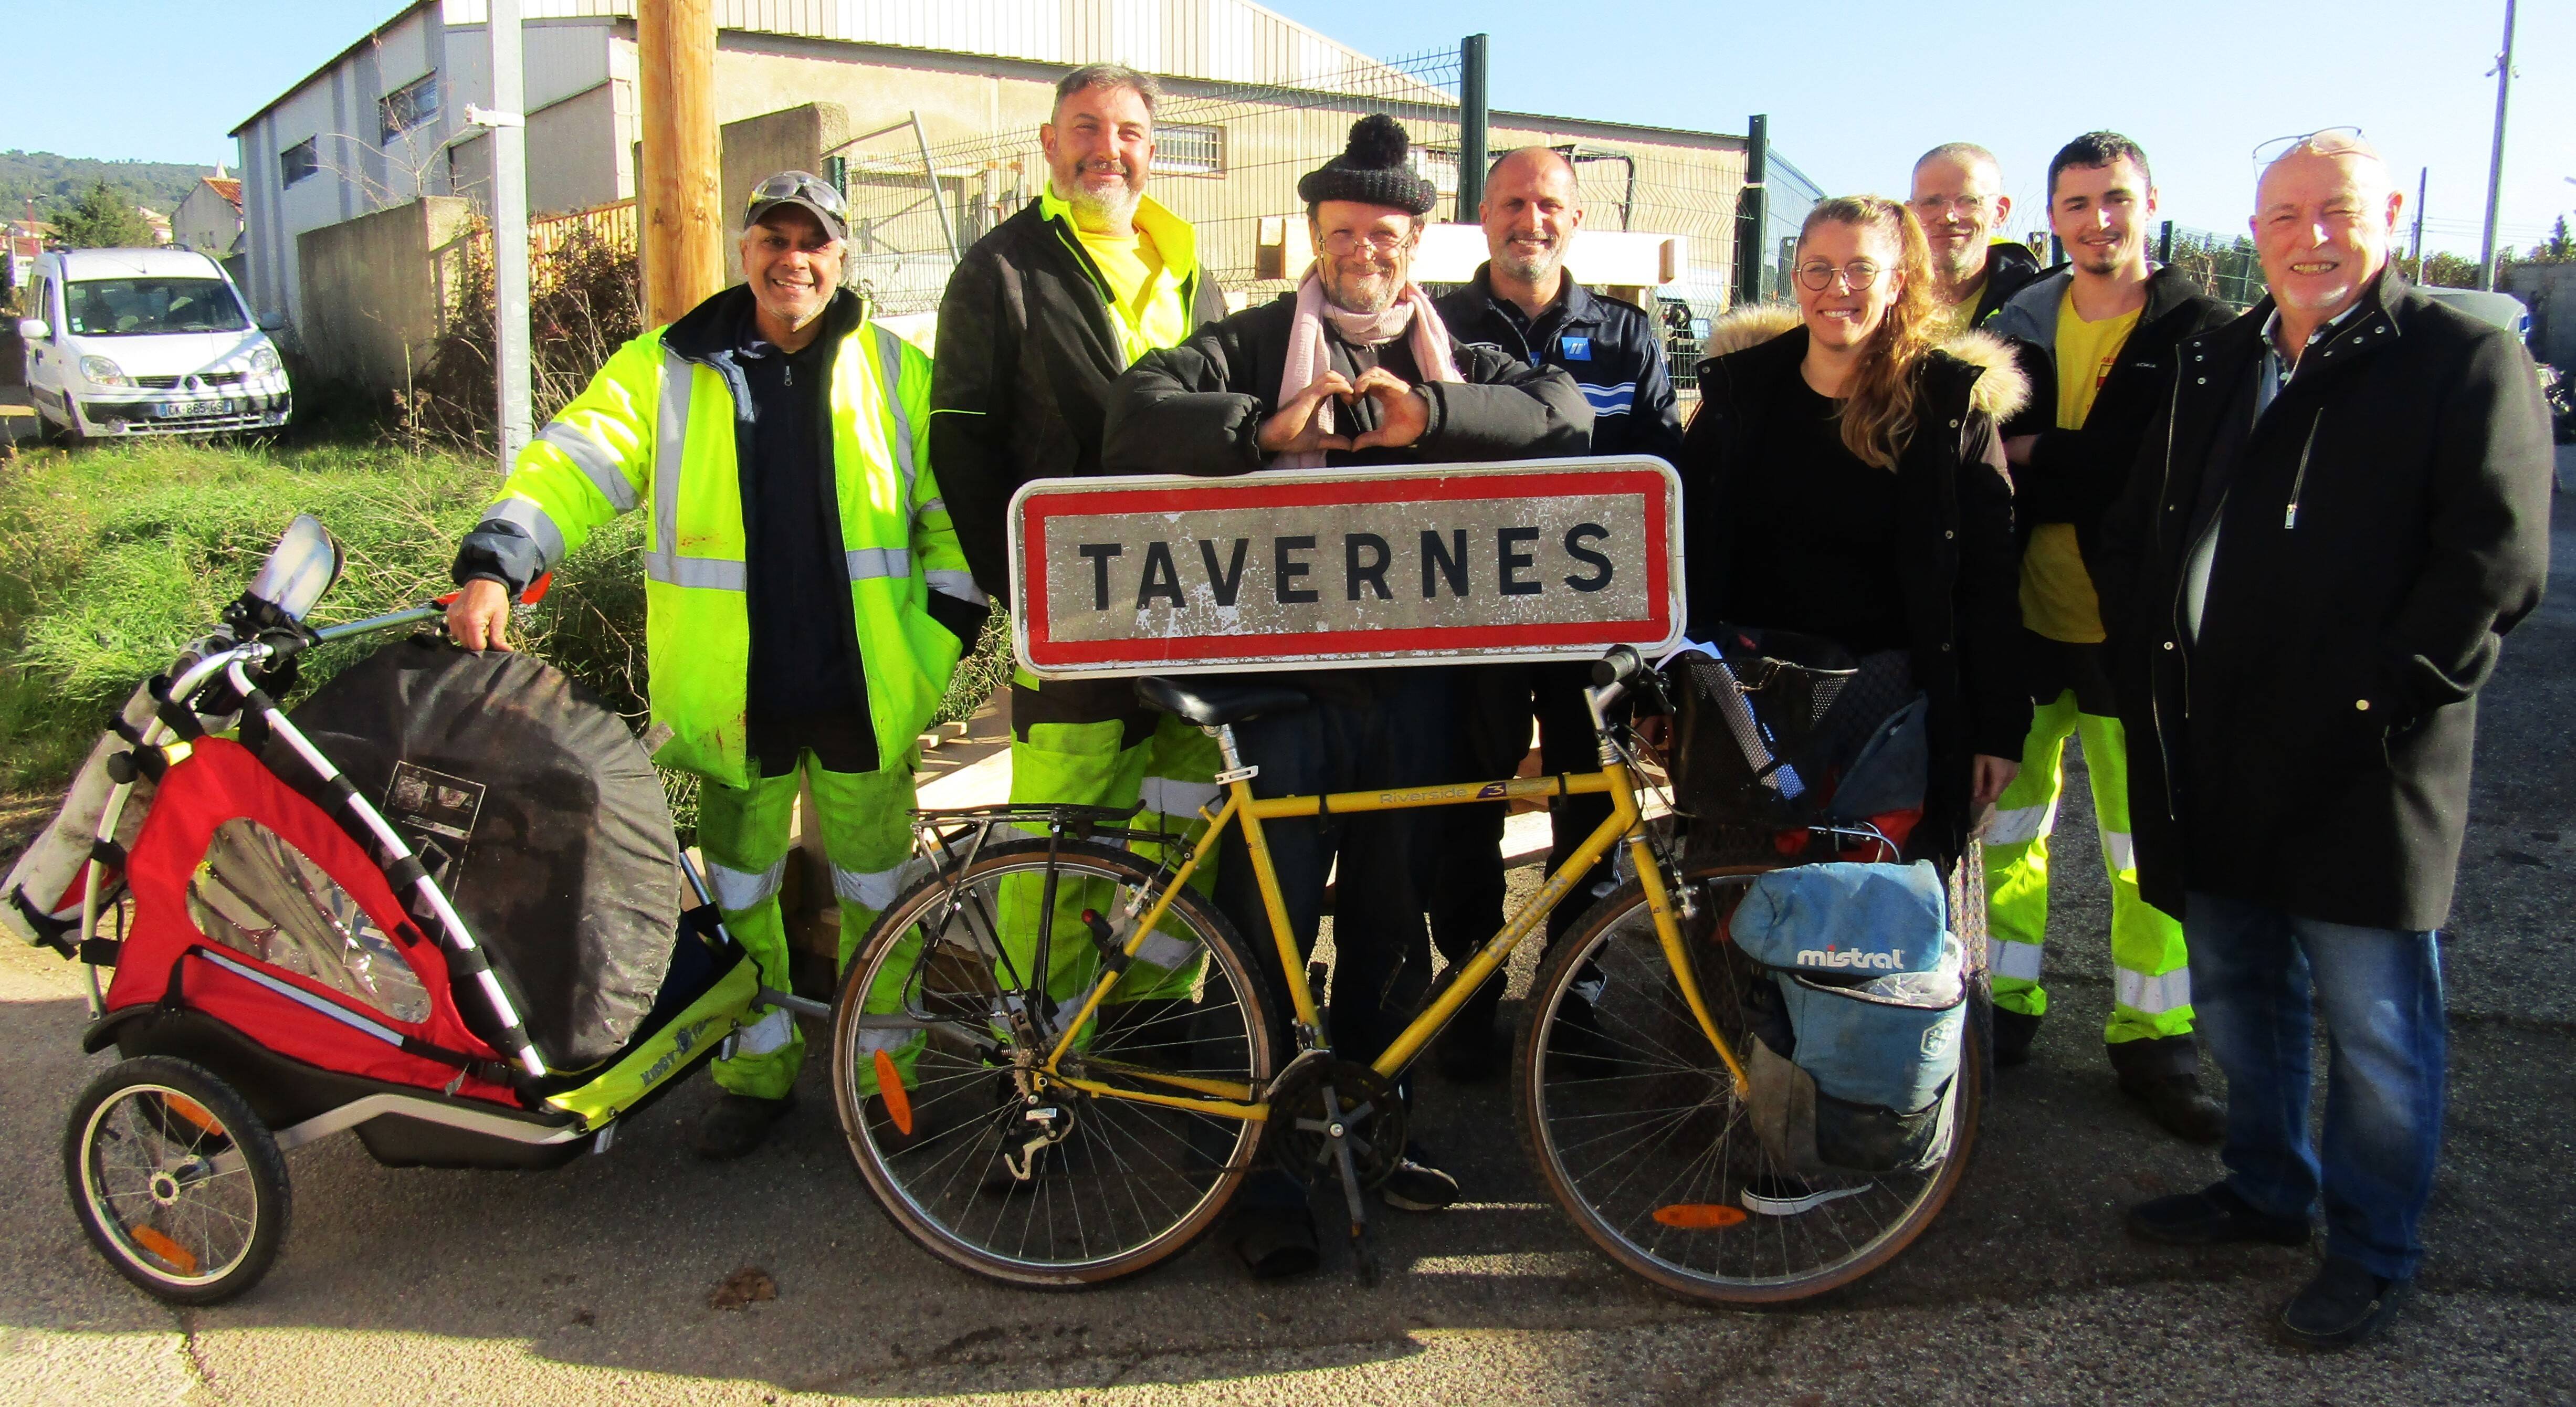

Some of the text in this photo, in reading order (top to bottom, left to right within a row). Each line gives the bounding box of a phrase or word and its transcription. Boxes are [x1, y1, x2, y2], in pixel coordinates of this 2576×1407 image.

[1079, 522, 1614, 611] TAVERNES
[1379, 787, 1467, 804] Riverside
[1797, 944, 1905, 970] mistral
